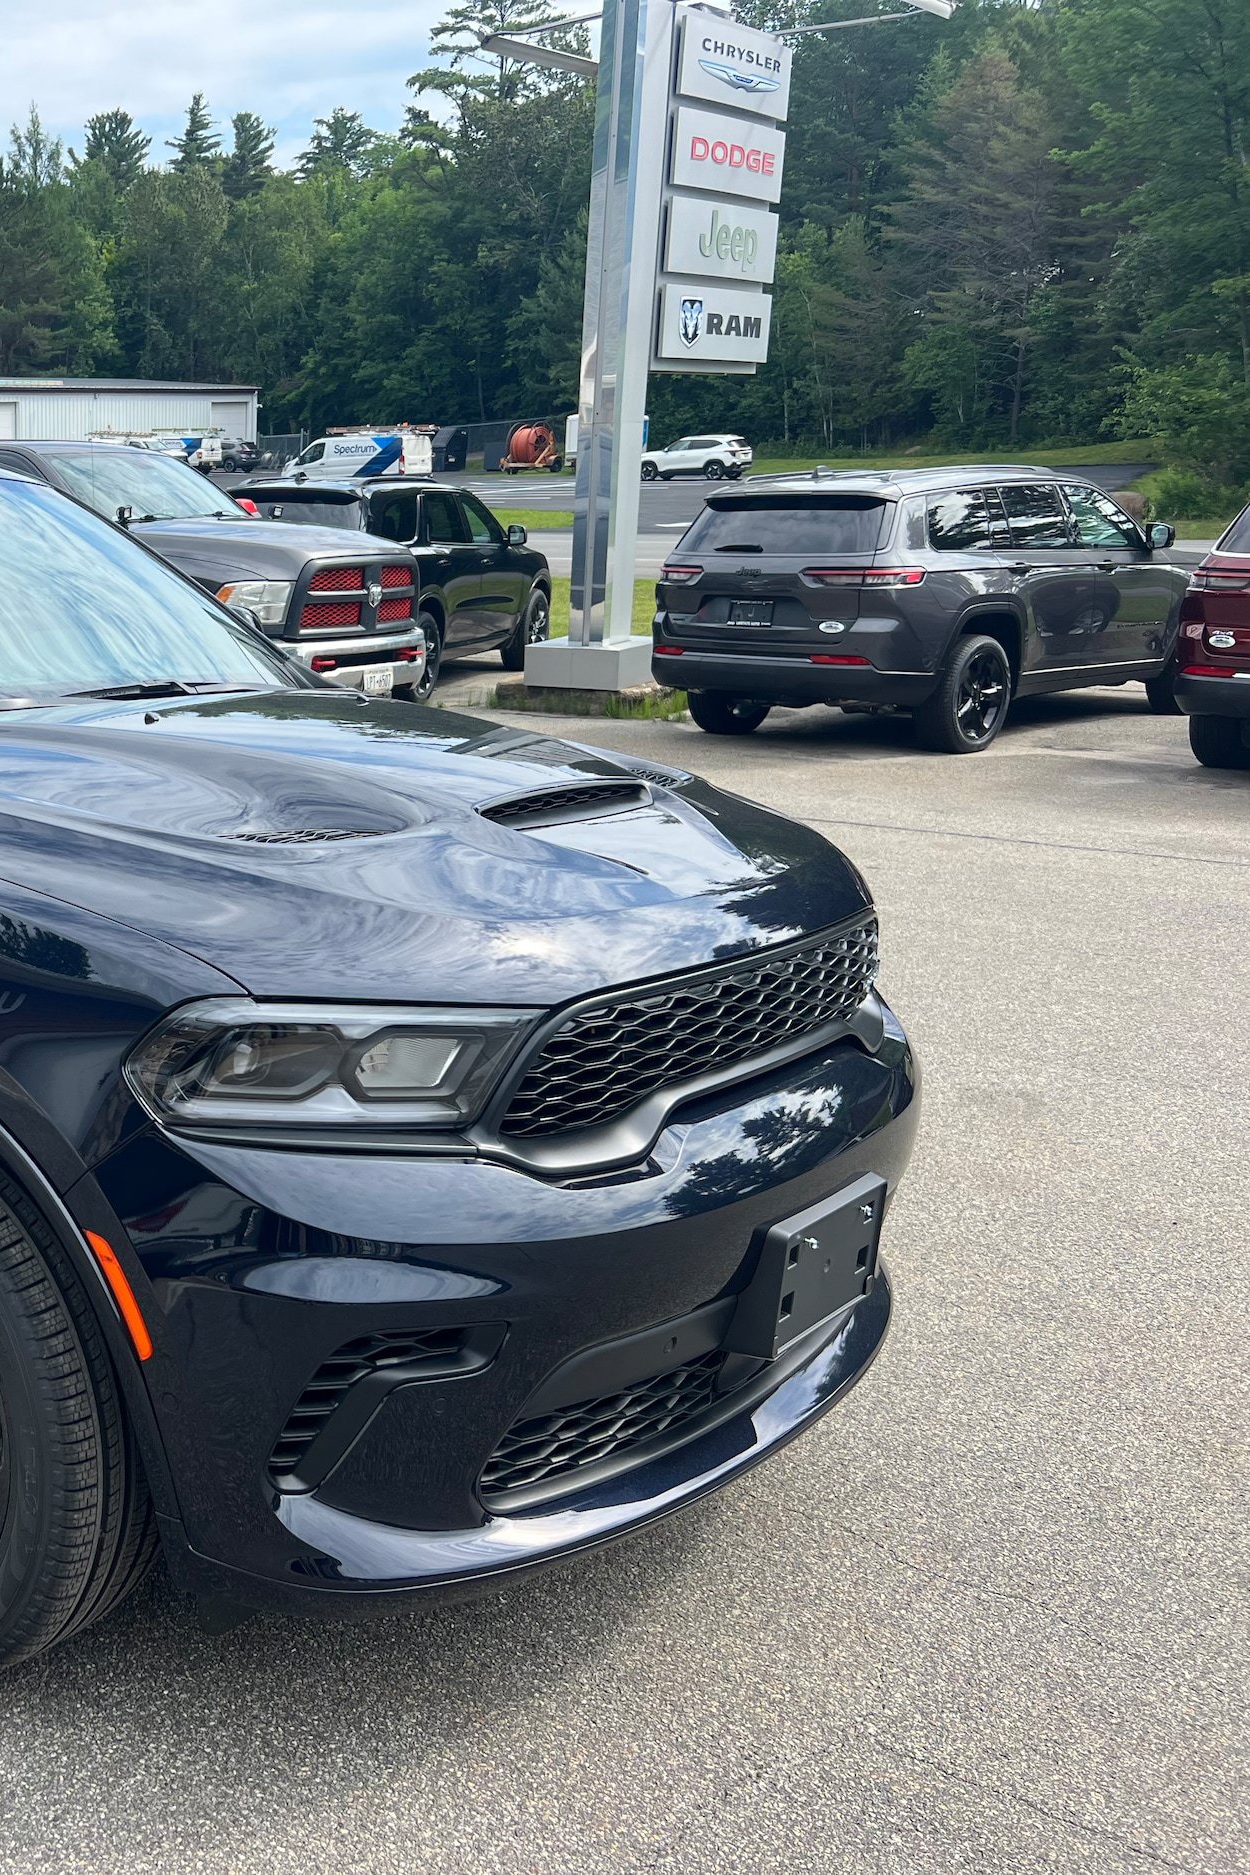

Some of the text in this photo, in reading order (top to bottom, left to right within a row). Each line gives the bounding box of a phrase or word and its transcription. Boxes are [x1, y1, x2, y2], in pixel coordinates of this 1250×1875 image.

[702, 37, 781, 73] CHRYSLER
[690, 136, 775, 176] DODGE
[699, 209, 758, 272] Jeep
[706, 312, 762, 339] RAM
[333, 444, 375, 456] Spectrum
[735, 566, 762, 578] Jeep
